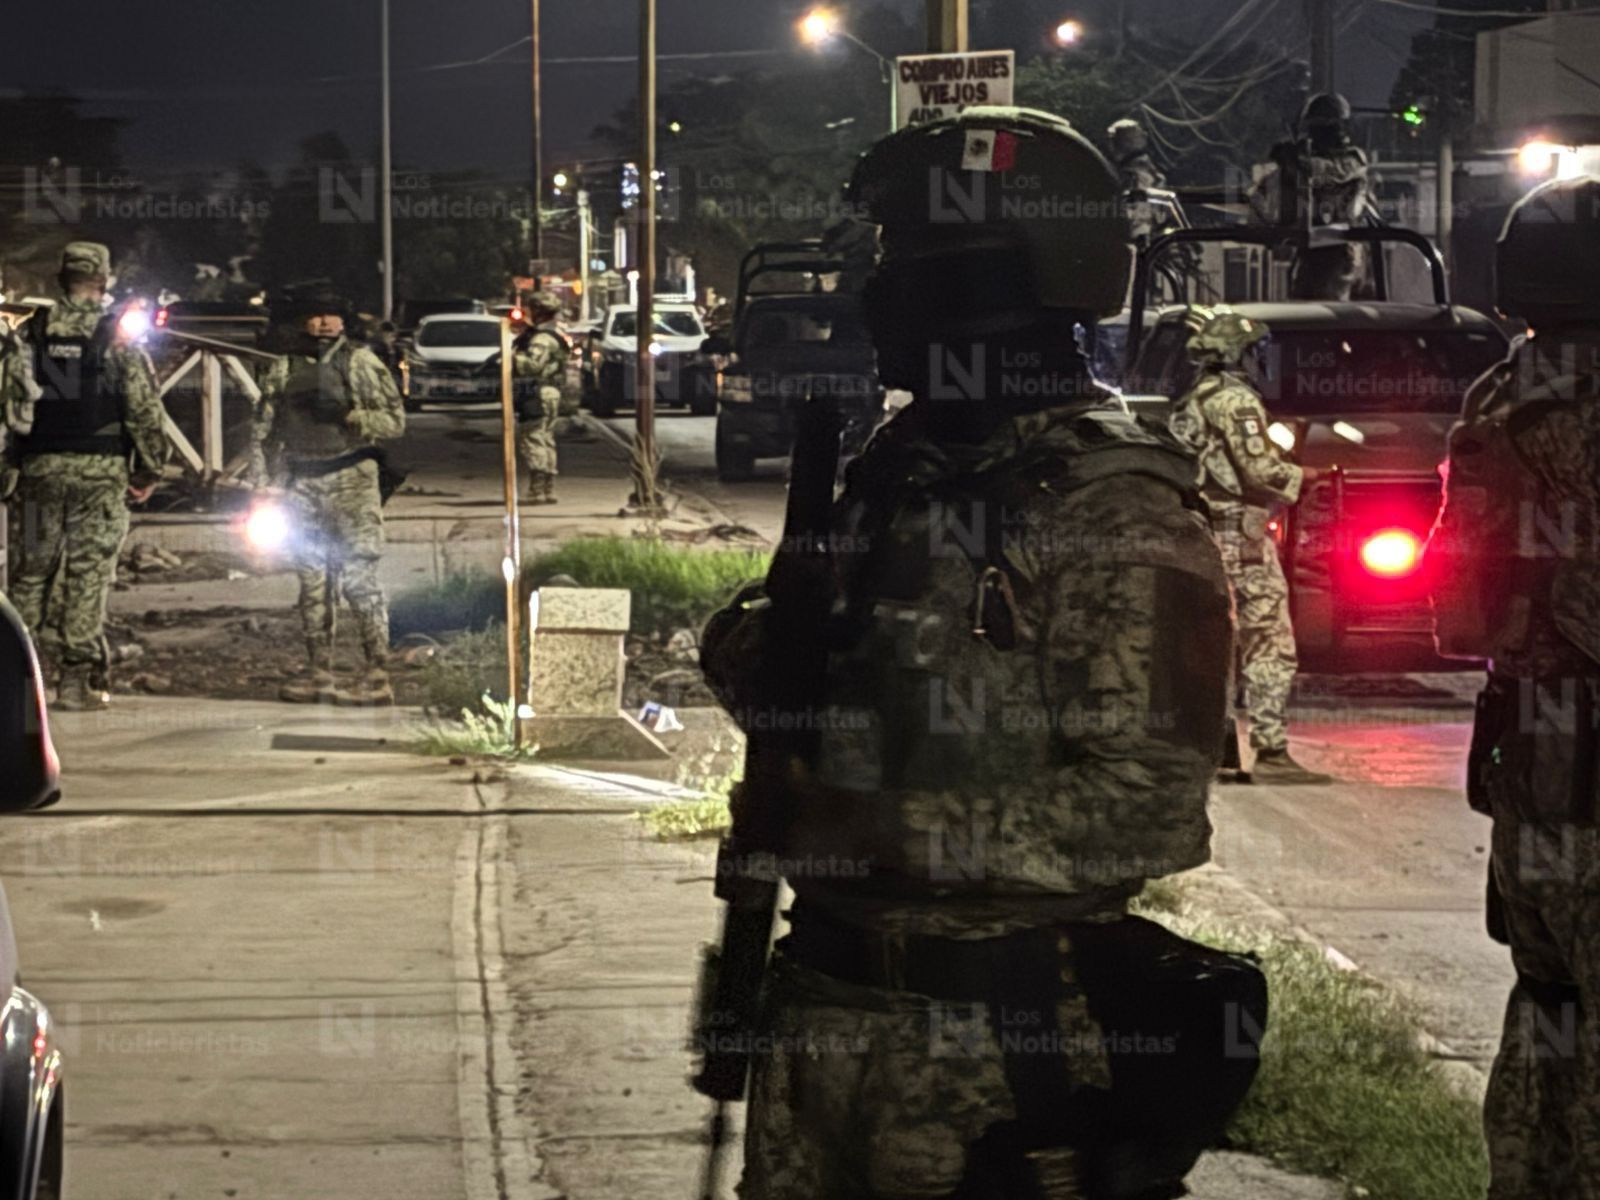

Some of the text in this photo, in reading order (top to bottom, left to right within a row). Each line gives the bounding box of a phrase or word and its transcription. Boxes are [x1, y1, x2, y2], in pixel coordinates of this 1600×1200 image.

[900, 55, 1011, 85] COMPRO AIRES
[919, 81, 989, 105] VIEJOS
